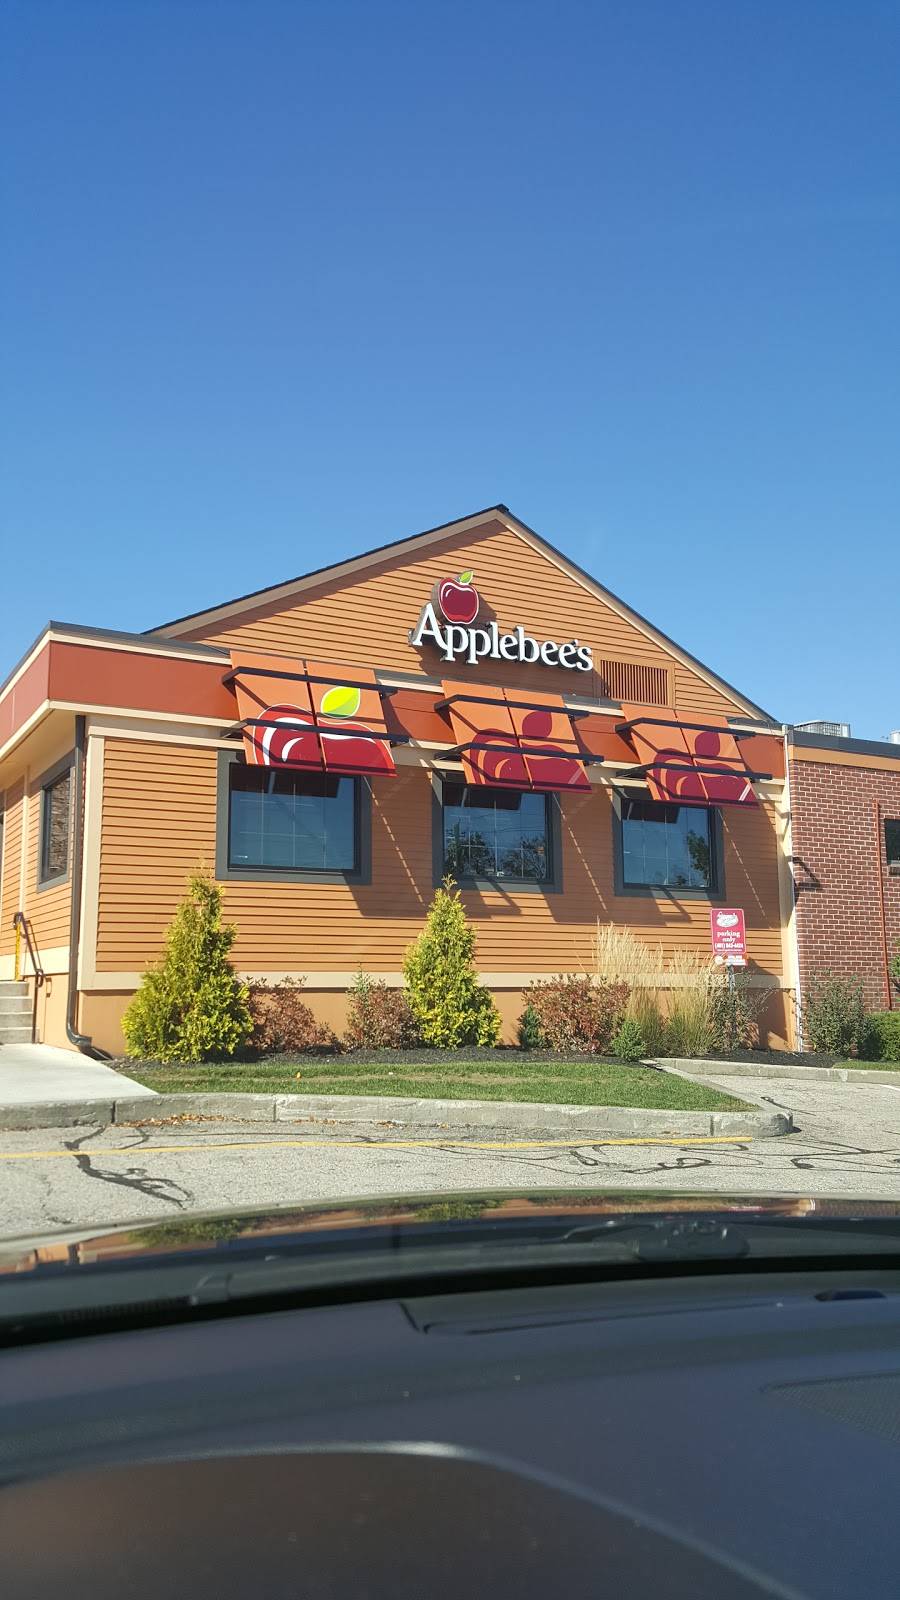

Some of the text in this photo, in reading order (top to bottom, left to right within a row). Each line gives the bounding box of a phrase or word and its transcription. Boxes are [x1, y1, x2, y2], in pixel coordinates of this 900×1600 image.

[410, 602, 593, 671] Applebee's
[717, 930, 741, 938] parking
[722, 936, 736, 944] only
